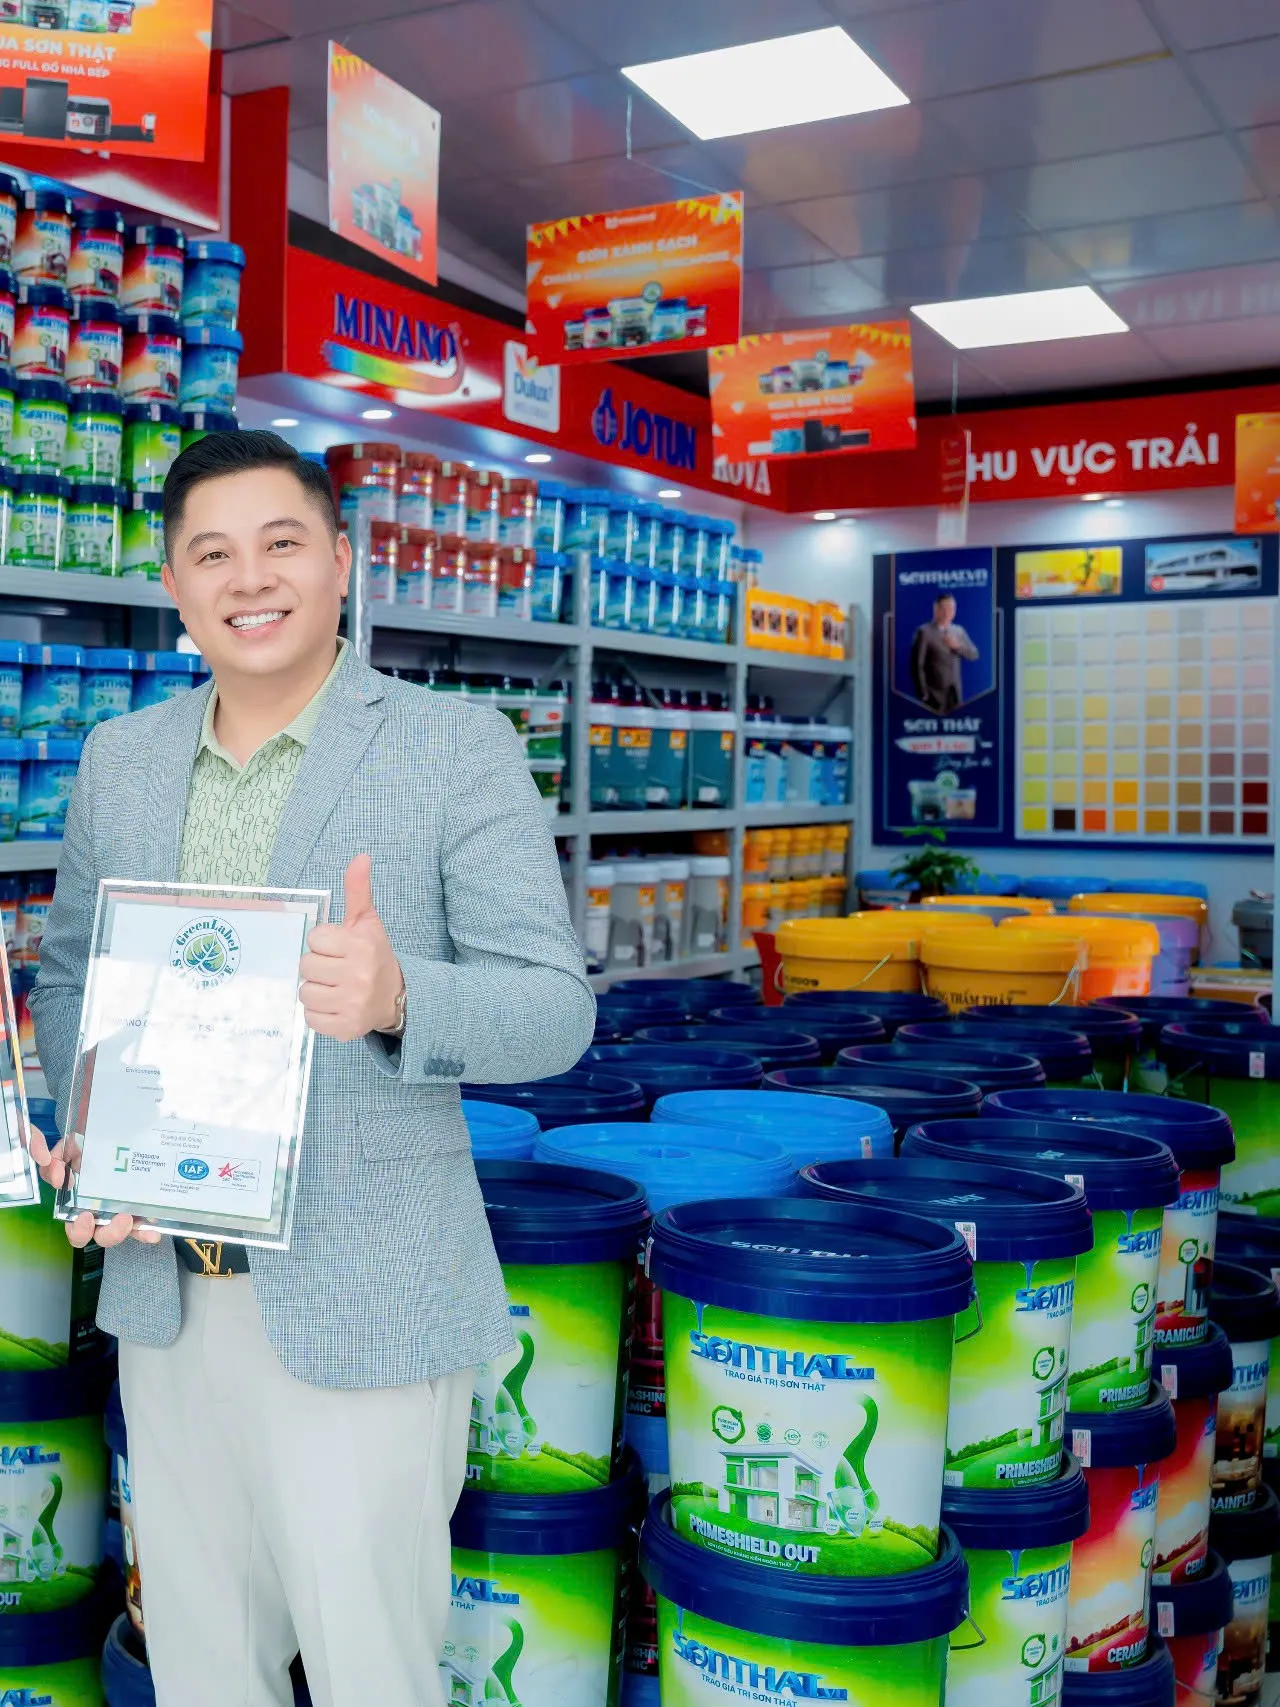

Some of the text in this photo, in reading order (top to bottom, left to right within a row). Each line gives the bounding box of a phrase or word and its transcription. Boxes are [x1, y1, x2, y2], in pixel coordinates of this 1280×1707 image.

[23, 37, 63, 55] SƠN
[67, 42, 116, 63] THẬT
[12, 60, 39, 72] FULL
[333, 293, 457, 366] MINANO
[620, 400, 696, 471] JOTUN
[968, 422, 1219, 485] HU VỰC TRẢI
[132, 1151, 160, 1160] Singapore
[183, 1164, 204, 1175] IAF
[724, 1369, 826, 1392] TRAO GIÁ TRỊ SƠN THẬT
[689, 1513, 820, 1564] PRIMESHIELD OUT
[701, 1673, 721, 1688] TRAO
[721, 1681, 736, 1694] GIÁ
[737, 1687, 751, 1700] TRỊ
[752, 1692, 772, 1704] SƠN
